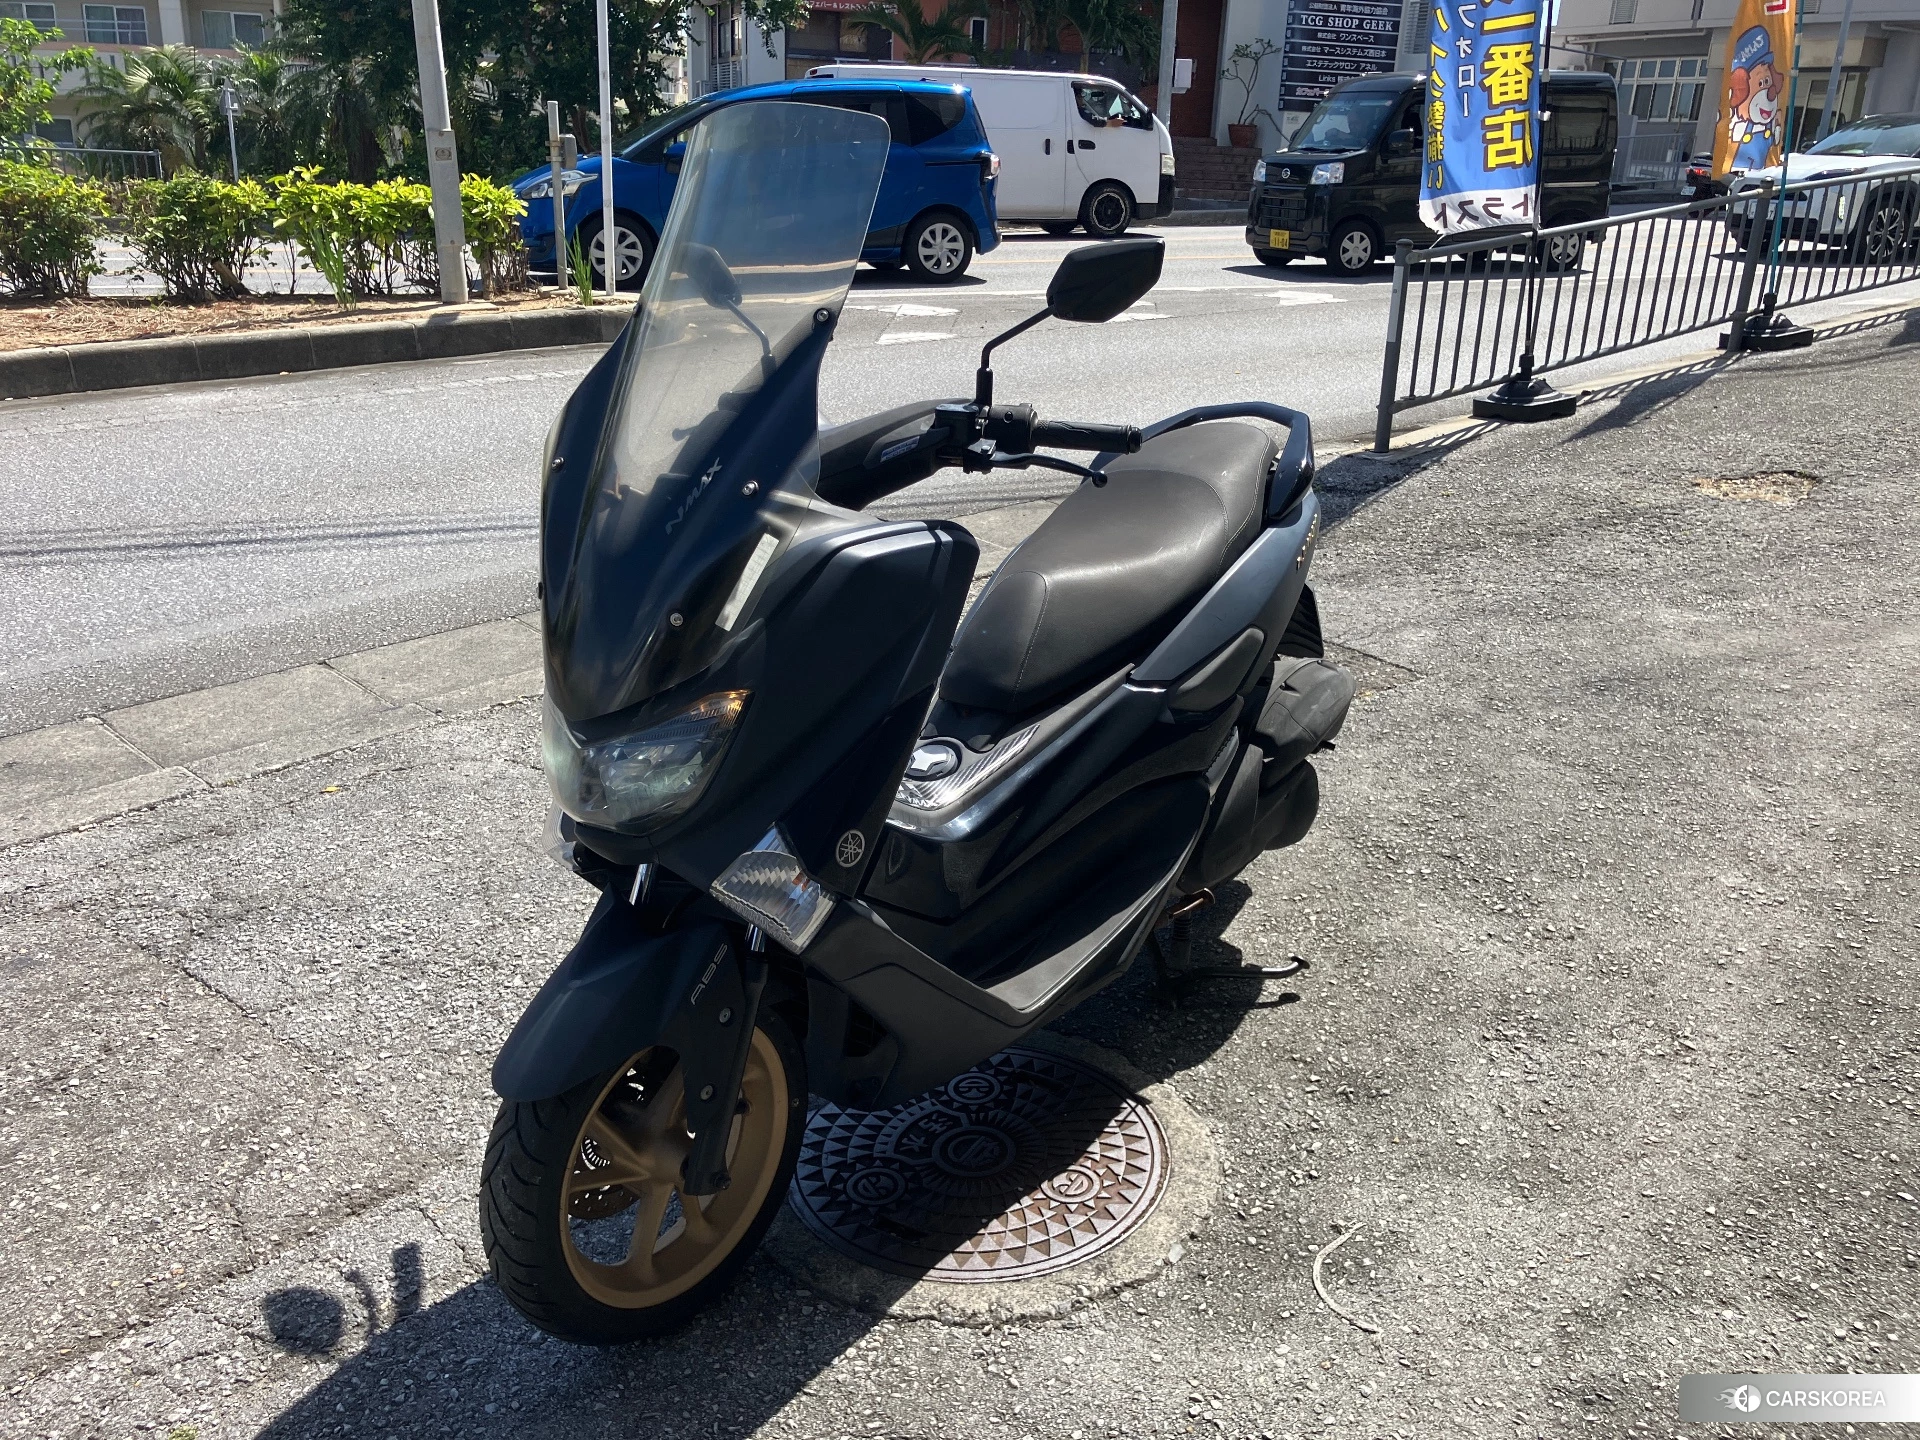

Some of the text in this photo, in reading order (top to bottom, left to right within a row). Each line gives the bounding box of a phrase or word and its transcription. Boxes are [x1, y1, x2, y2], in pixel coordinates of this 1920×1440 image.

[1300, 14, 1394, 31] TCG SHOP GEEK
[1318, 75, 1336, 83] Links
[664, 456, 723, 536] NMAX
[690, 942, 728, 1006] ABS
